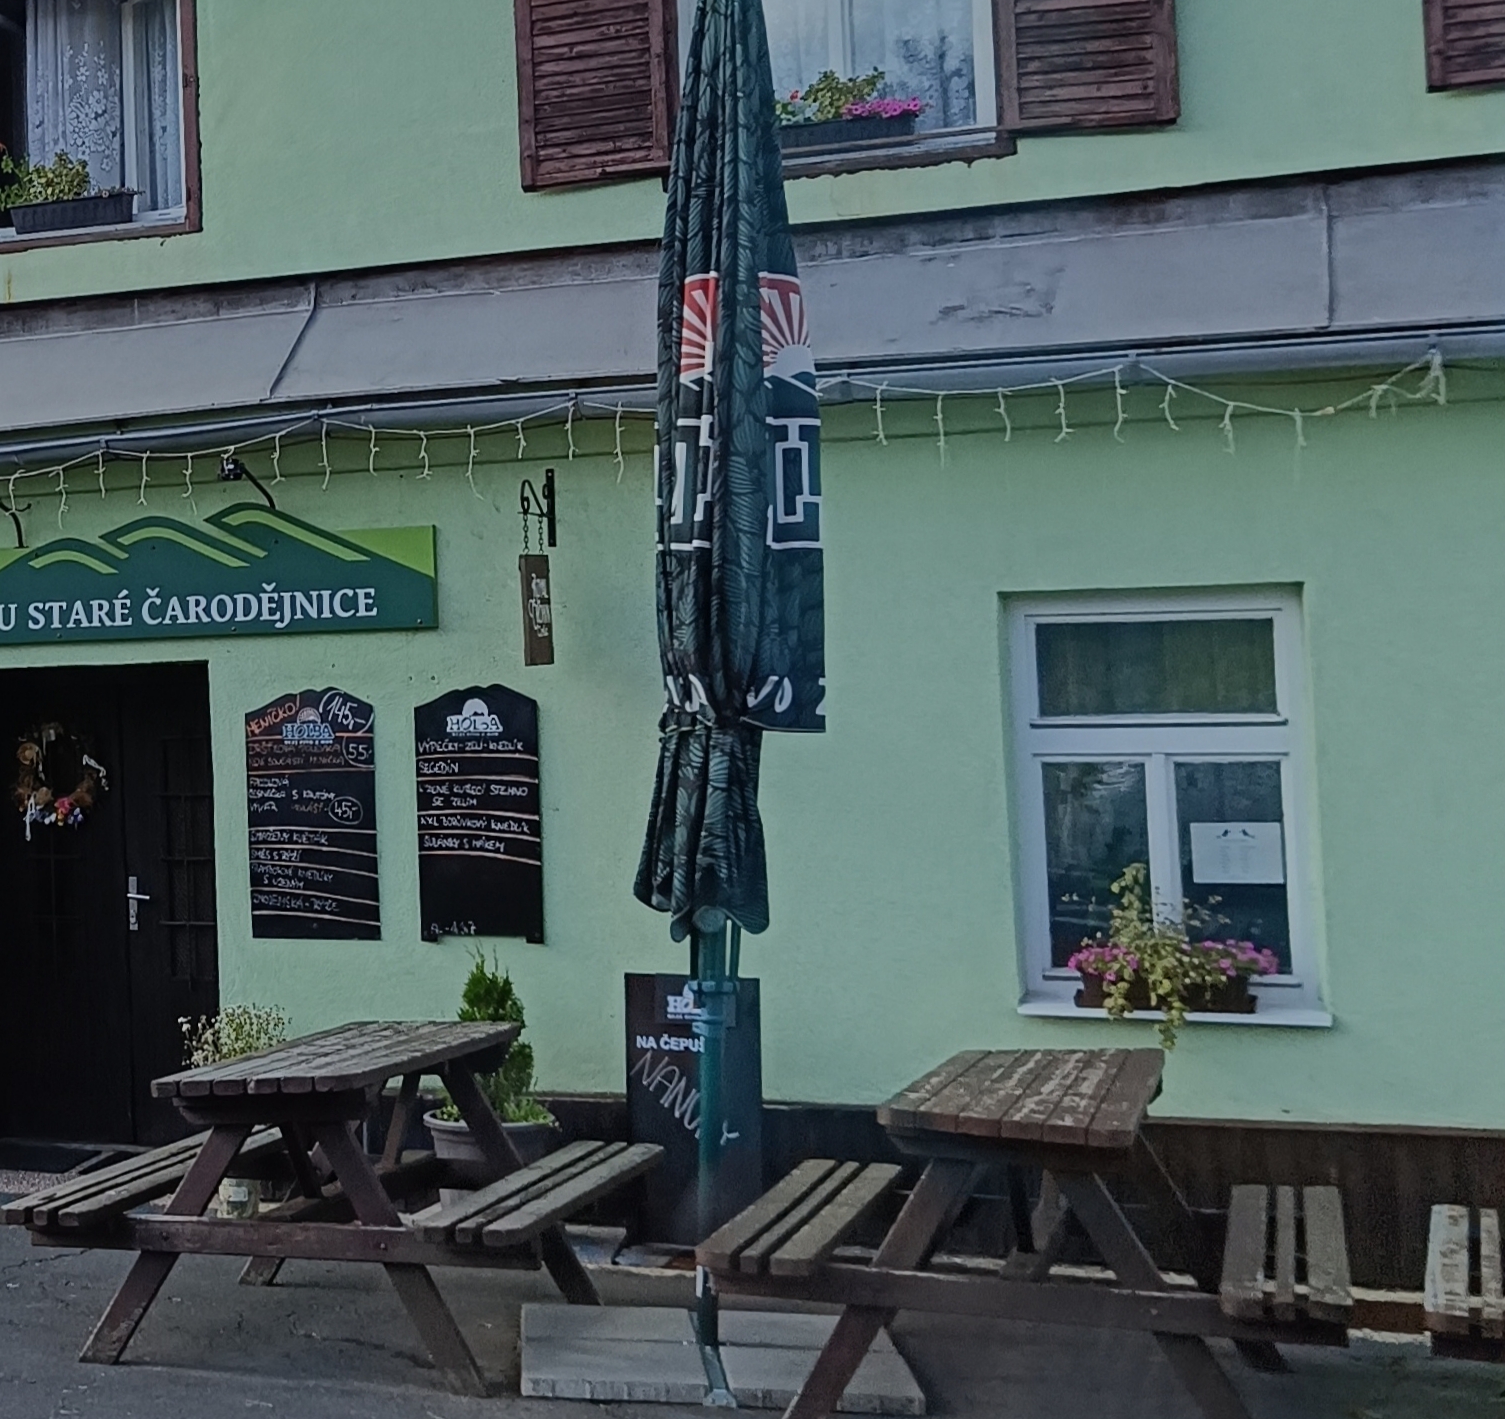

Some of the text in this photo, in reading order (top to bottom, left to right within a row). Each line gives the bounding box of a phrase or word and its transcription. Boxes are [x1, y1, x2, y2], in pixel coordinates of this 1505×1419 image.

[28, 589, 133, 630] STARÉ
[141, 582, 378, 630] ČARODĚJNICE
[282, 723, 335, 739] HOLBA
[636, 1034, 657, 1049] NA
